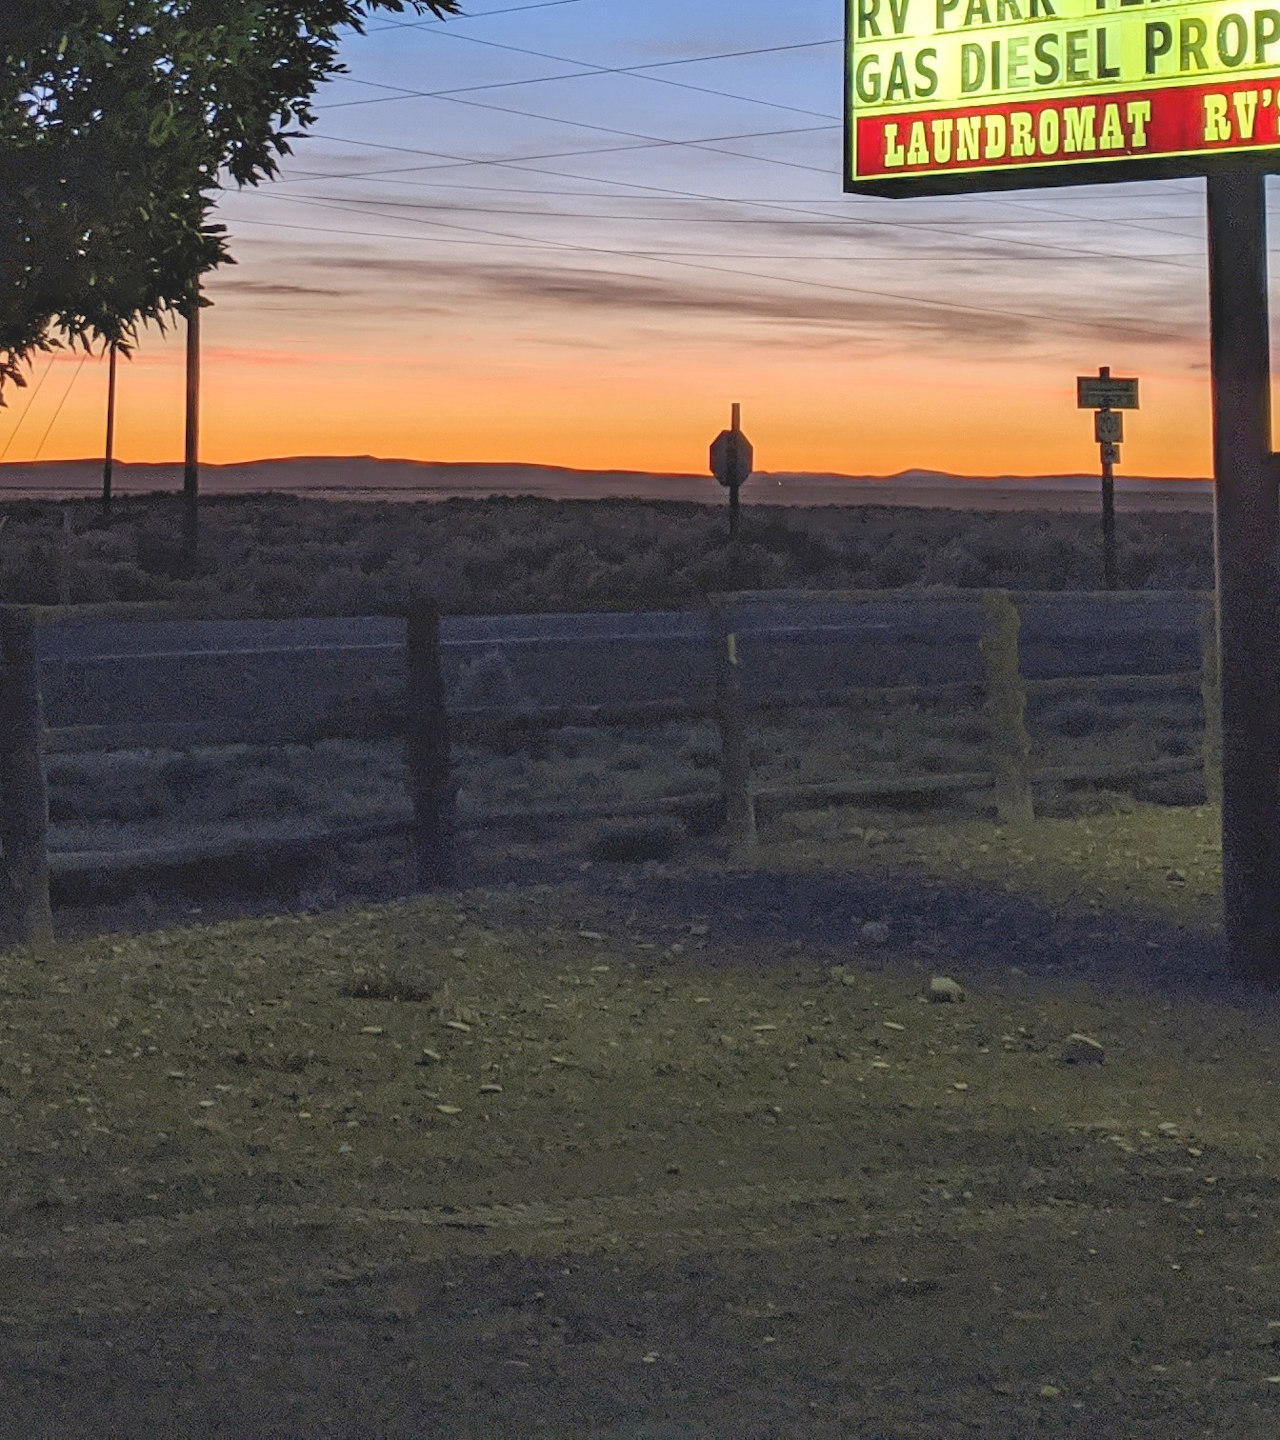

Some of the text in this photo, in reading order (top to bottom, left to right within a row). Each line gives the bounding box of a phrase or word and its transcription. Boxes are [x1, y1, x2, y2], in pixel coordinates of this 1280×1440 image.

[856, 47, 938, 103] GAS
[961, 27, 1120, 94] DIESEL
[884, 100, 1151, 168] LAUNDROMAT
